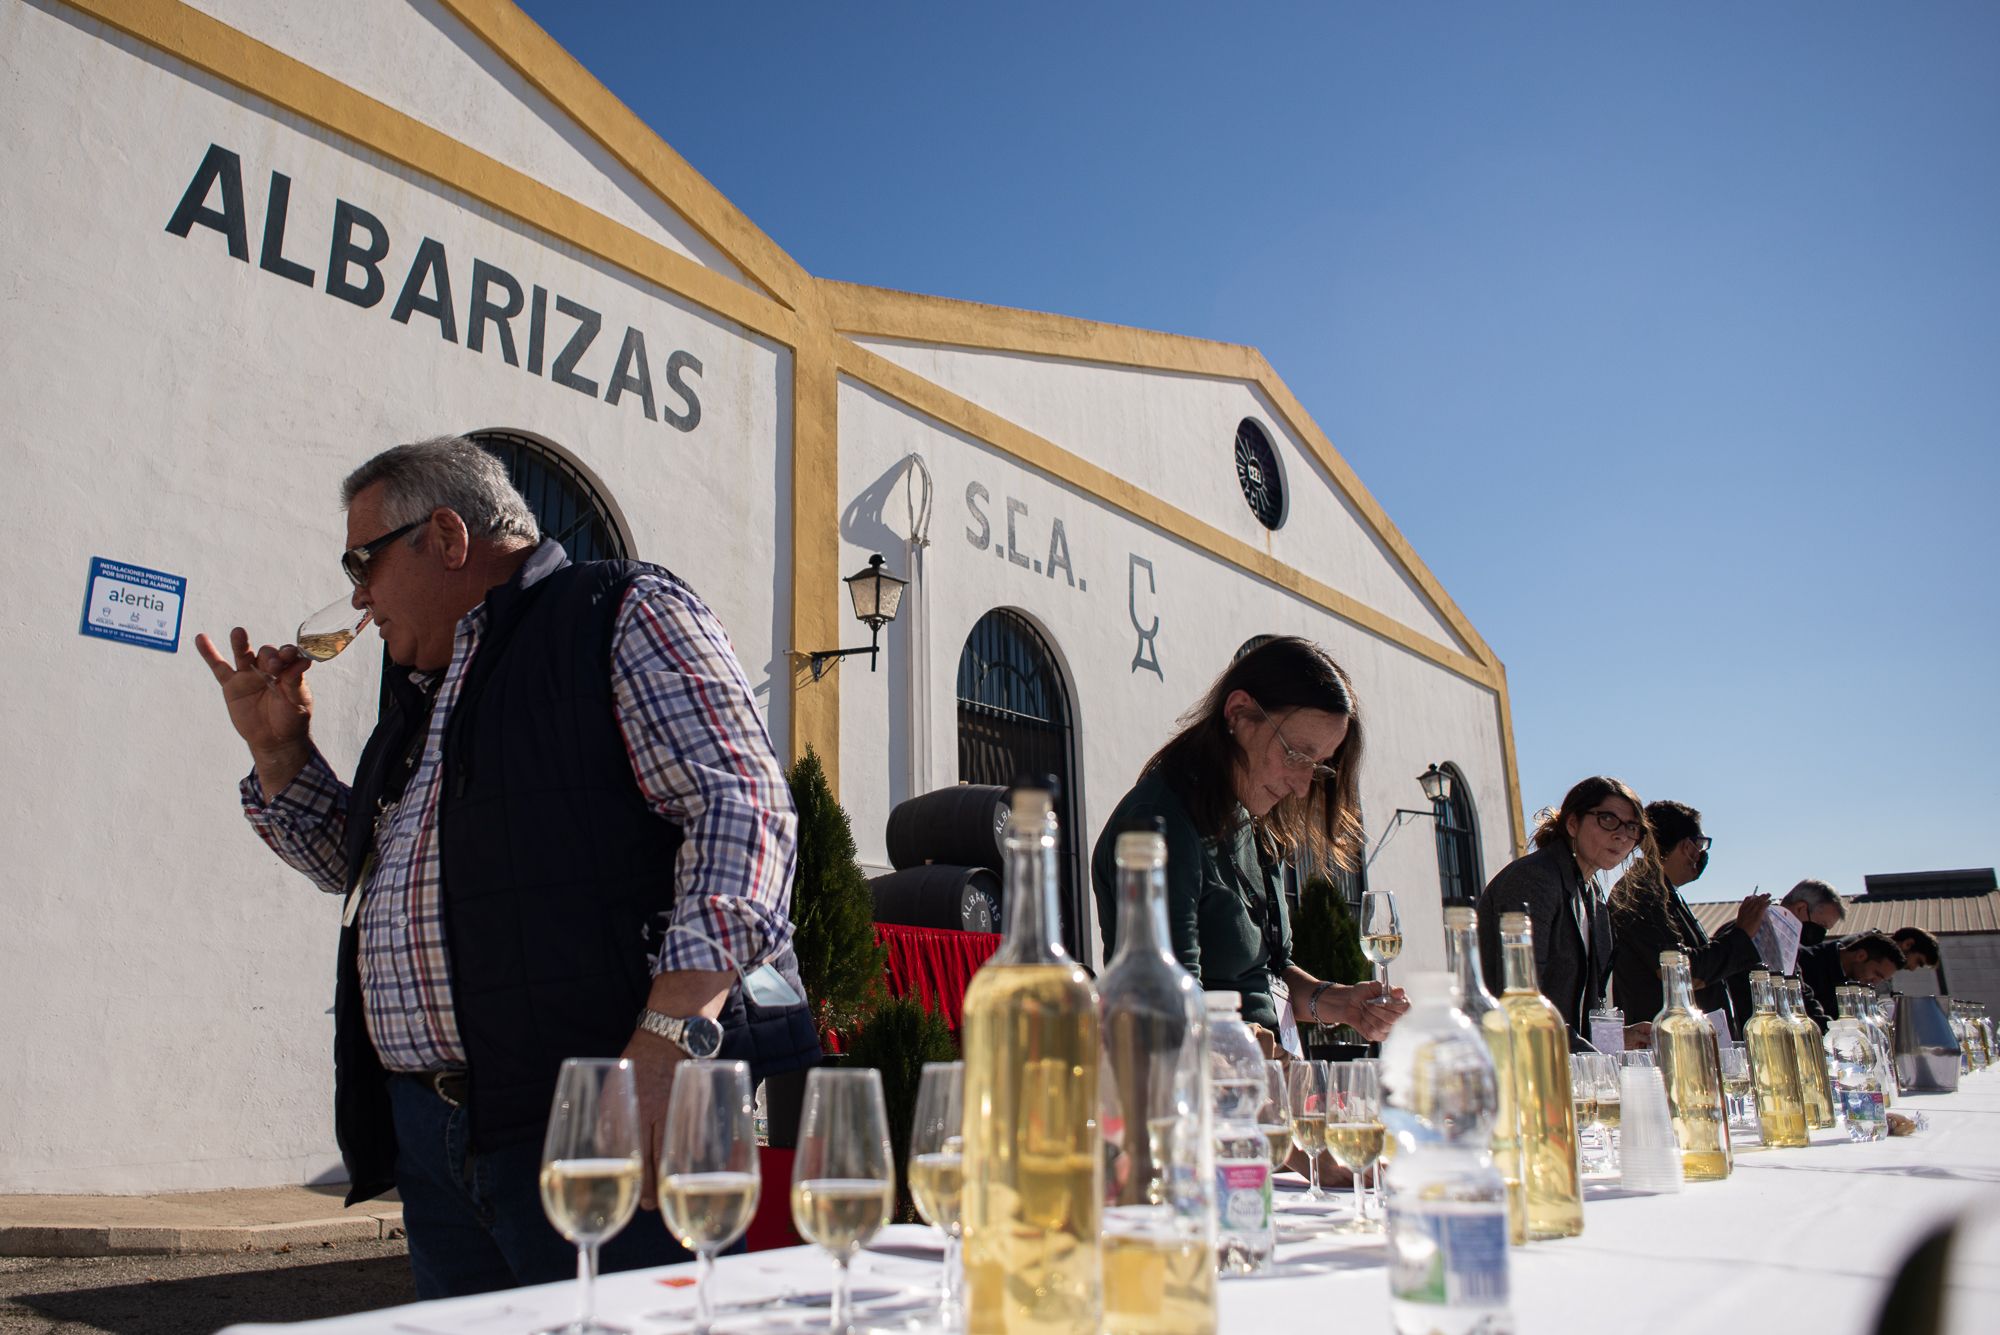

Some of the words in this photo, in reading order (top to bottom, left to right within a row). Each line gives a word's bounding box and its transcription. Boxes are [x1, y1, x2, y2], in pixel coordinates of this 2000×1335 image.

[164, 142, 705, 434] ALBARIZAS
[965, 480, 1087, 593] S.C.A.
[100, 562, 145, 576] INSTALACIONES
[145, 573, 179, 586] PROTEGIDAS
[102, 569, 115, 577] POR
[115, 573, 140, 583] SISTEMA
[149, 580, 176, 592] ALARMAS
[962, 892, 1001, 921] ALBARIZAS
